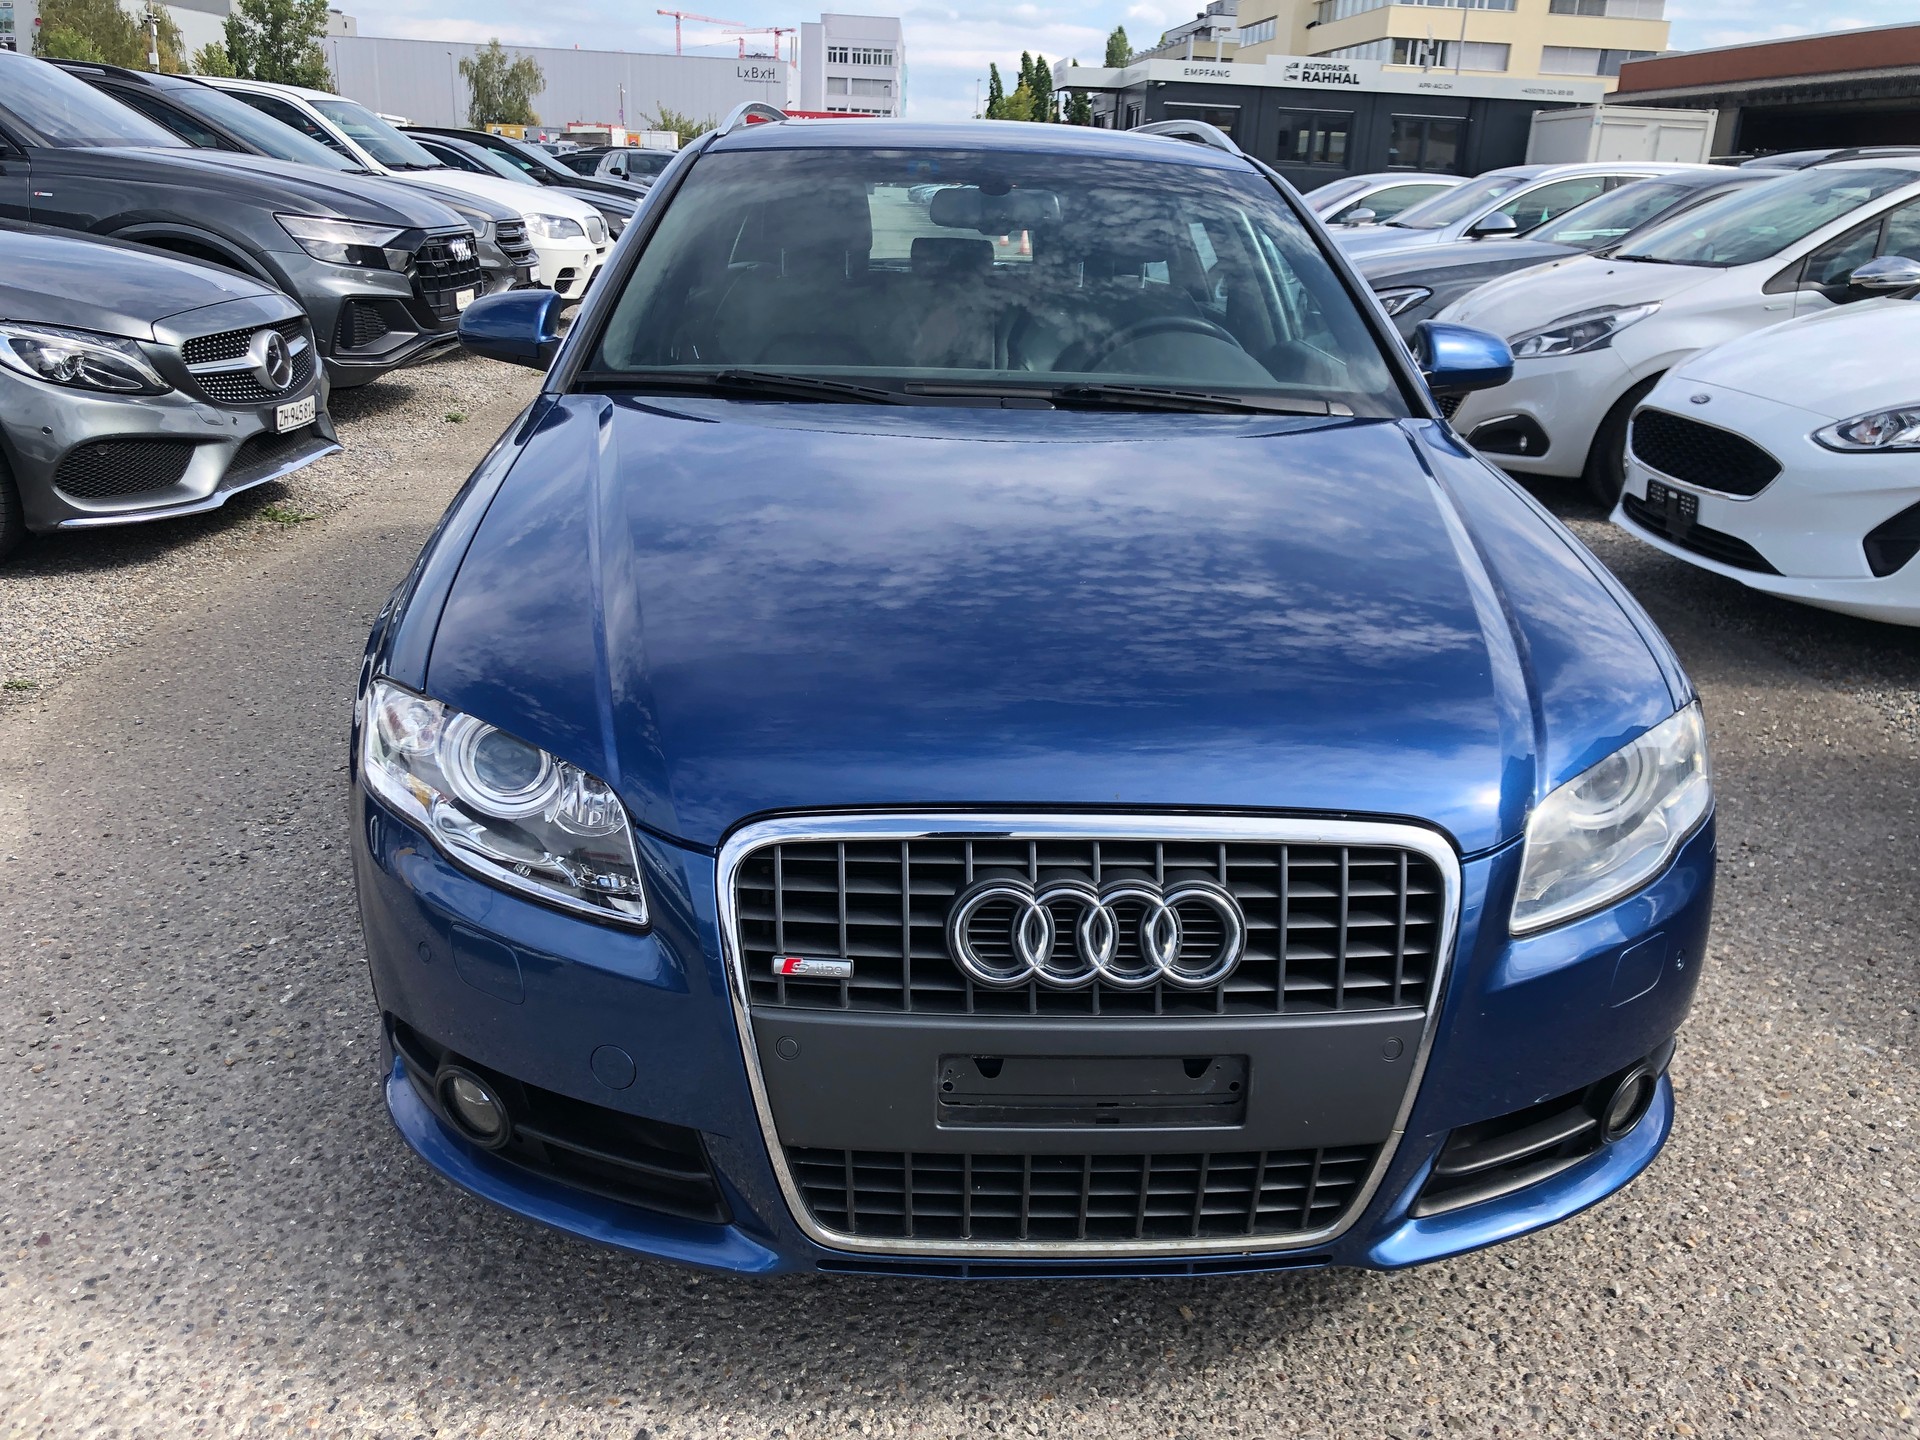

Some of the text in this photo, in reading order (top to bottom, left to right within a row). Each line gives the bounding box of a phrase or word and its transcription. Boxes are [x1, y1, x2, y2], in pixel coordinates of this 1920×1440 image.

[1184, 68, 1231, 78] EMPFANG
[1303, 63, 1349, 71] AUTOPARK
[1301, 71, 1360, 85] RAHHAL
[816, 962, 843, 976] line
